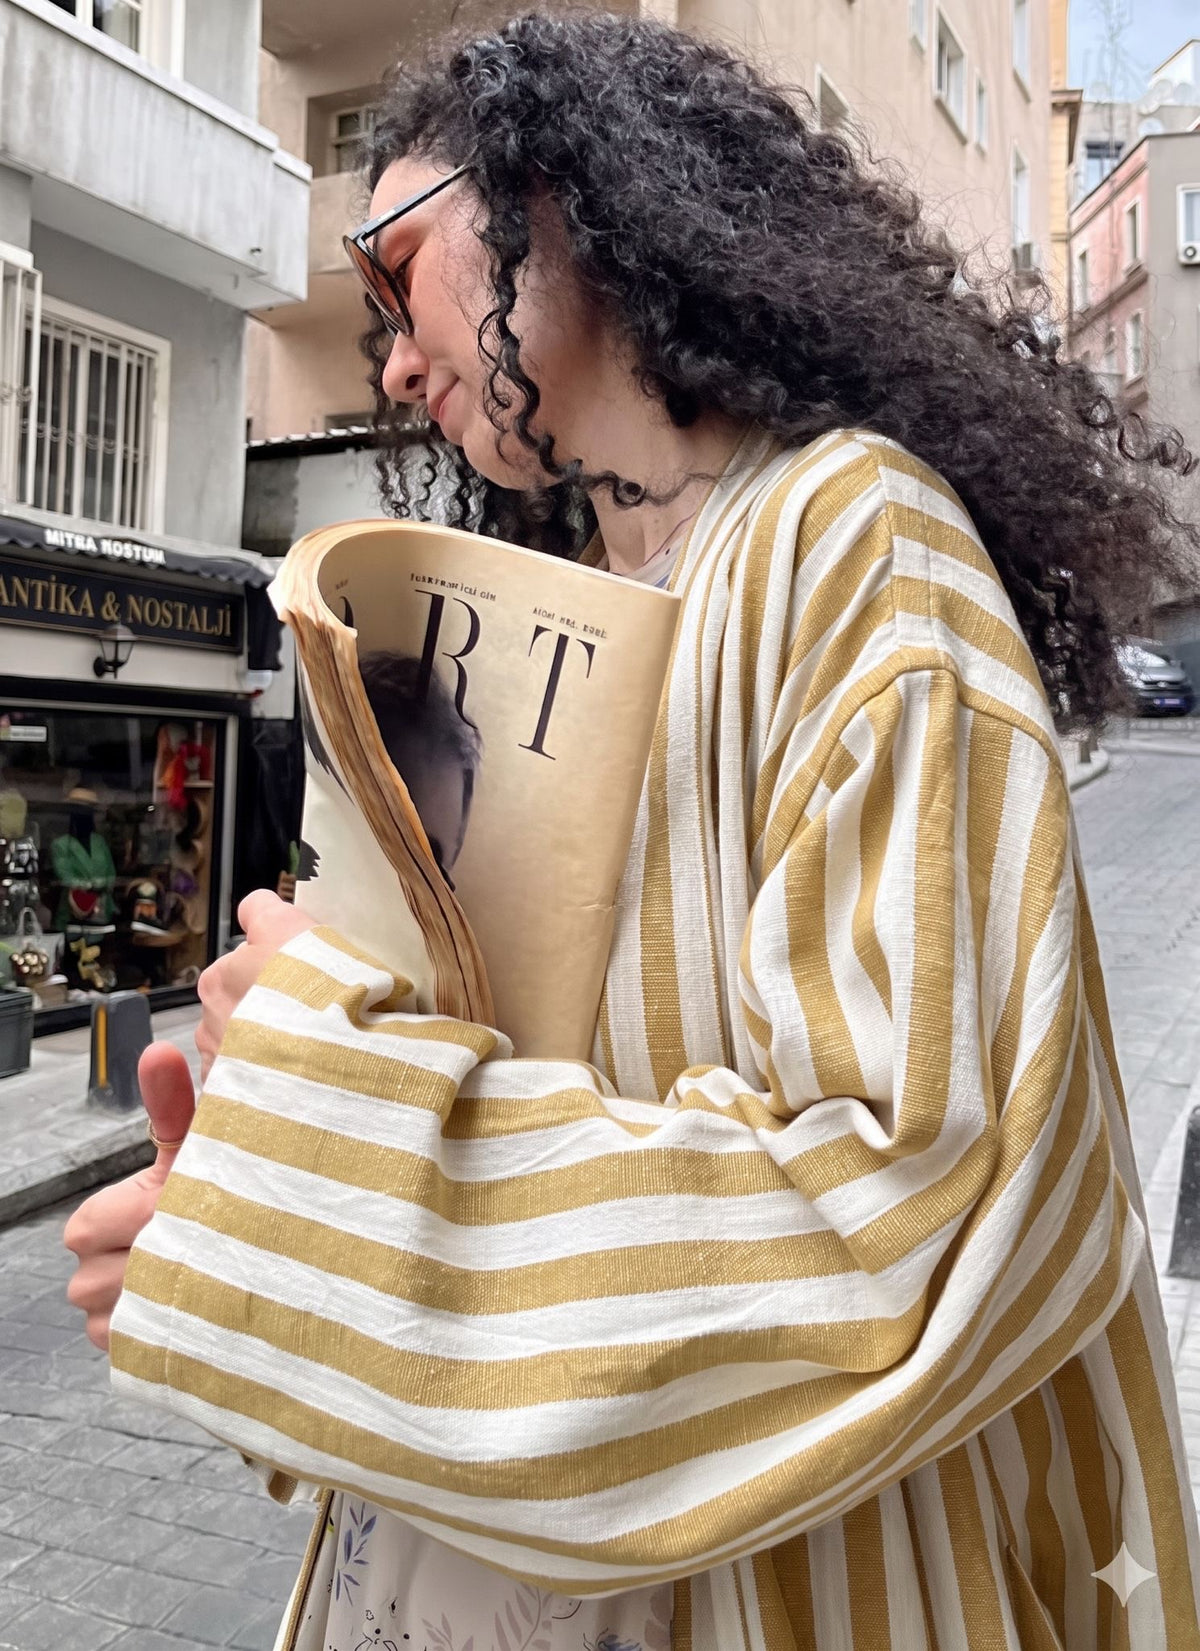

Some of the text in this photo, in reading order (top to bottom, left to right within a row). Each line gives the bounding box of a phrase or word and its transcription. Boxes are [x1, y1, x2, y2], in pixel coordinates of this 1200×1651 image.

[45, 528, 98, 553] MITRA
[0, 573, 232, 637] ANTİKA & NOSTALJİ
